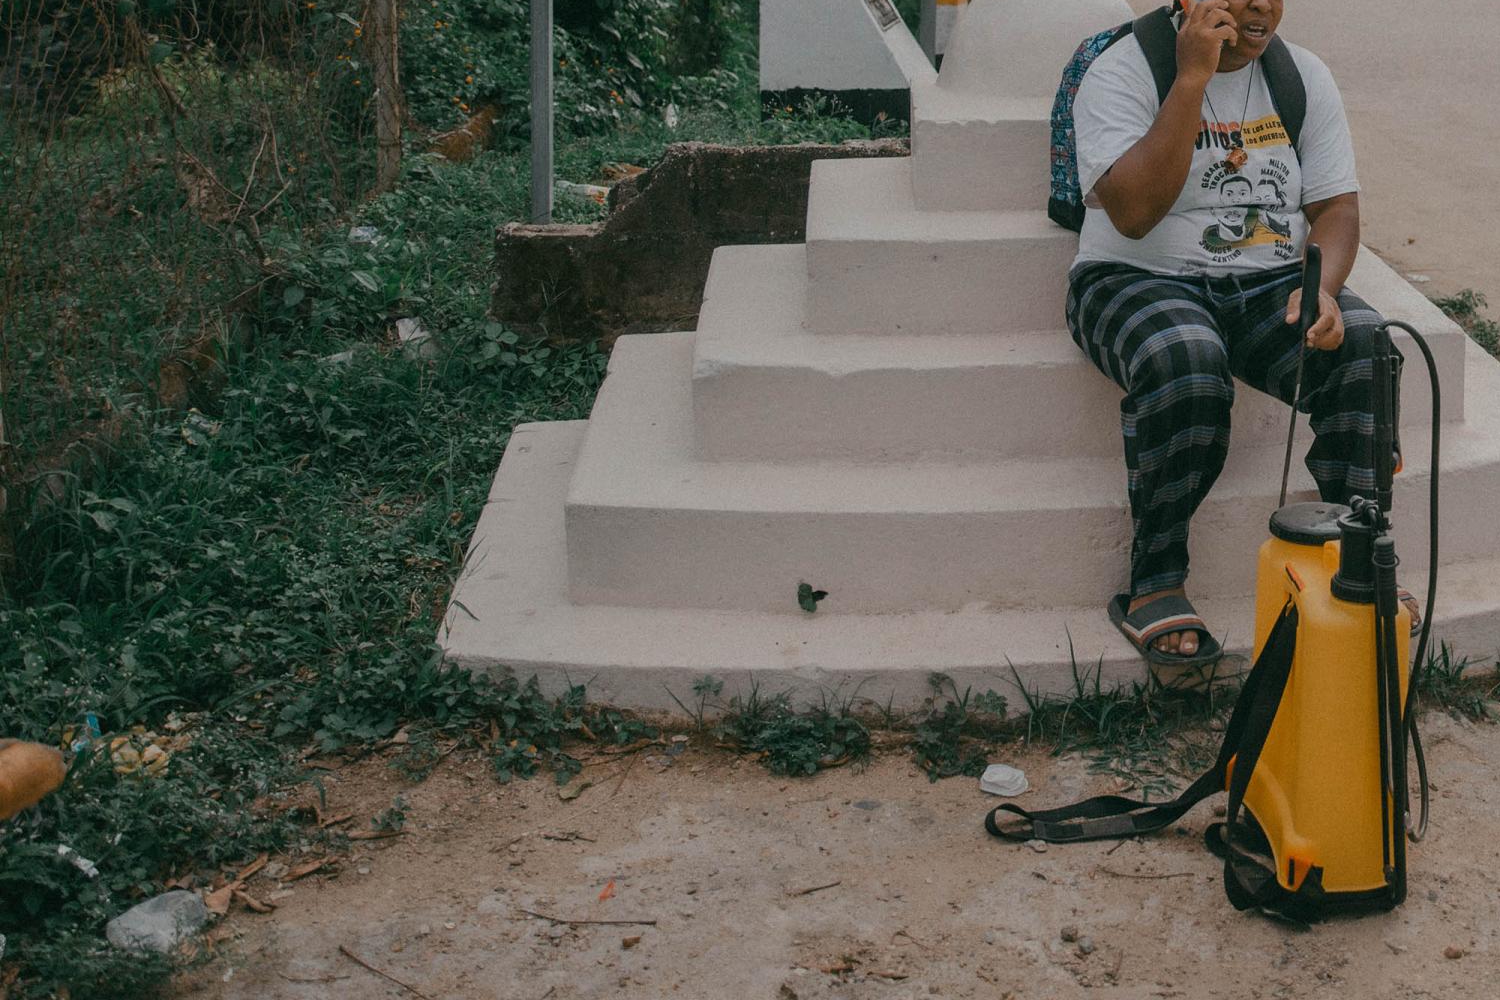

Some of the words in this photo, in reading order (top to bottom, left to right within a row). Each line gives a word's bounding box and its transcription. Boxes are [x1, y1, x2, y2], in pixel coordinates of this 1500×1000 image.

[1252, 124, 1264, 134] LOS
[1246, 137, 1257, 145] LOS
[1201, 160, 1226, 188] GERARD
[1269, 158, 1290, 177] MILTON
[1260, 168, 1287, 187] MARTINEZ
